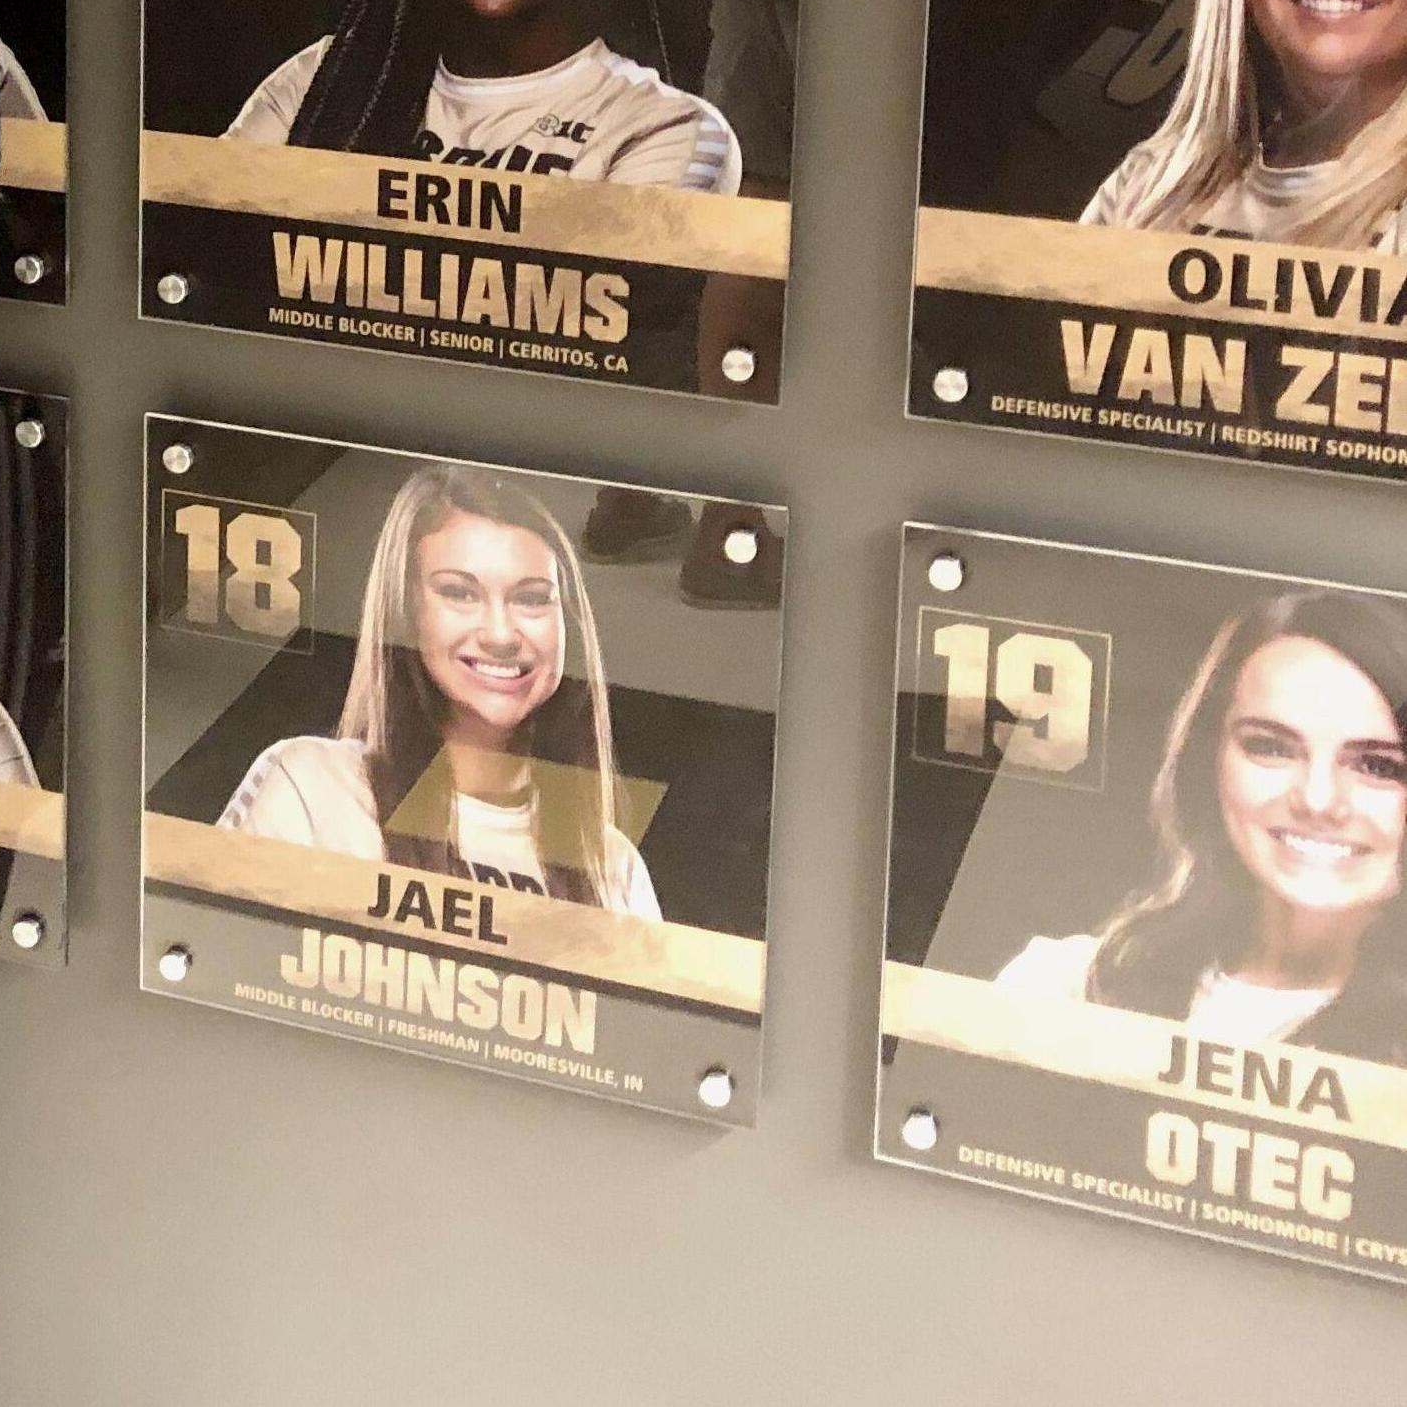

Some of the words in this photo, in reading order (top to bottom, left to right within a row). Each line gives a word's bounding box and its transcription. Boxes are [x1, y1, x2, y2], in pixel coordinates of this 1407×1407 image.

[376, 168, 523, 234] ERIN
[268, 307, 334, 331] MIDDLE
[338, 316, 416, 342] BLOCKER
[429, 329, 494, 353] SENIOR
[509, 341, 599, 370] CERRITOS,
[604, 354, 629, 373] CA
[272, 231, 630, 344] WILLIAMS
[1060, 319, 1247, 415] VAN
[991, 395, 1092, 424] DEFENSIVE
[1098, 408, 1206, 438] SPECIALIST
[1222, 425, 1320, 454] REDSHIRT
[175, 503, 302, 637] 18
[934, 623, 1093, 773] 19
[366, 872, 508, 946] JAEL
[234, 983, 297, 1011] MIDDLE
[301, 997, 375, 1028] BLOCKER
[388, 1019, 480, 1053] FRESHMAN
[494, 1044, 619, 1089] MOORESVILLE,
[624, 1074, 643, 1092] IN
[280, 926, 598, 1055] JOHNSON
[1158, 1035, 1353, 1123] JENA
[958, 1144, 1066, 1185] DEFENSIVE
[1071, 1171, 1186, 1213] SPECIALIST
[1201, 1202, 1338, 1250] SOPHOMORE
[1146, 1110, 1355, 1222] OTEC
